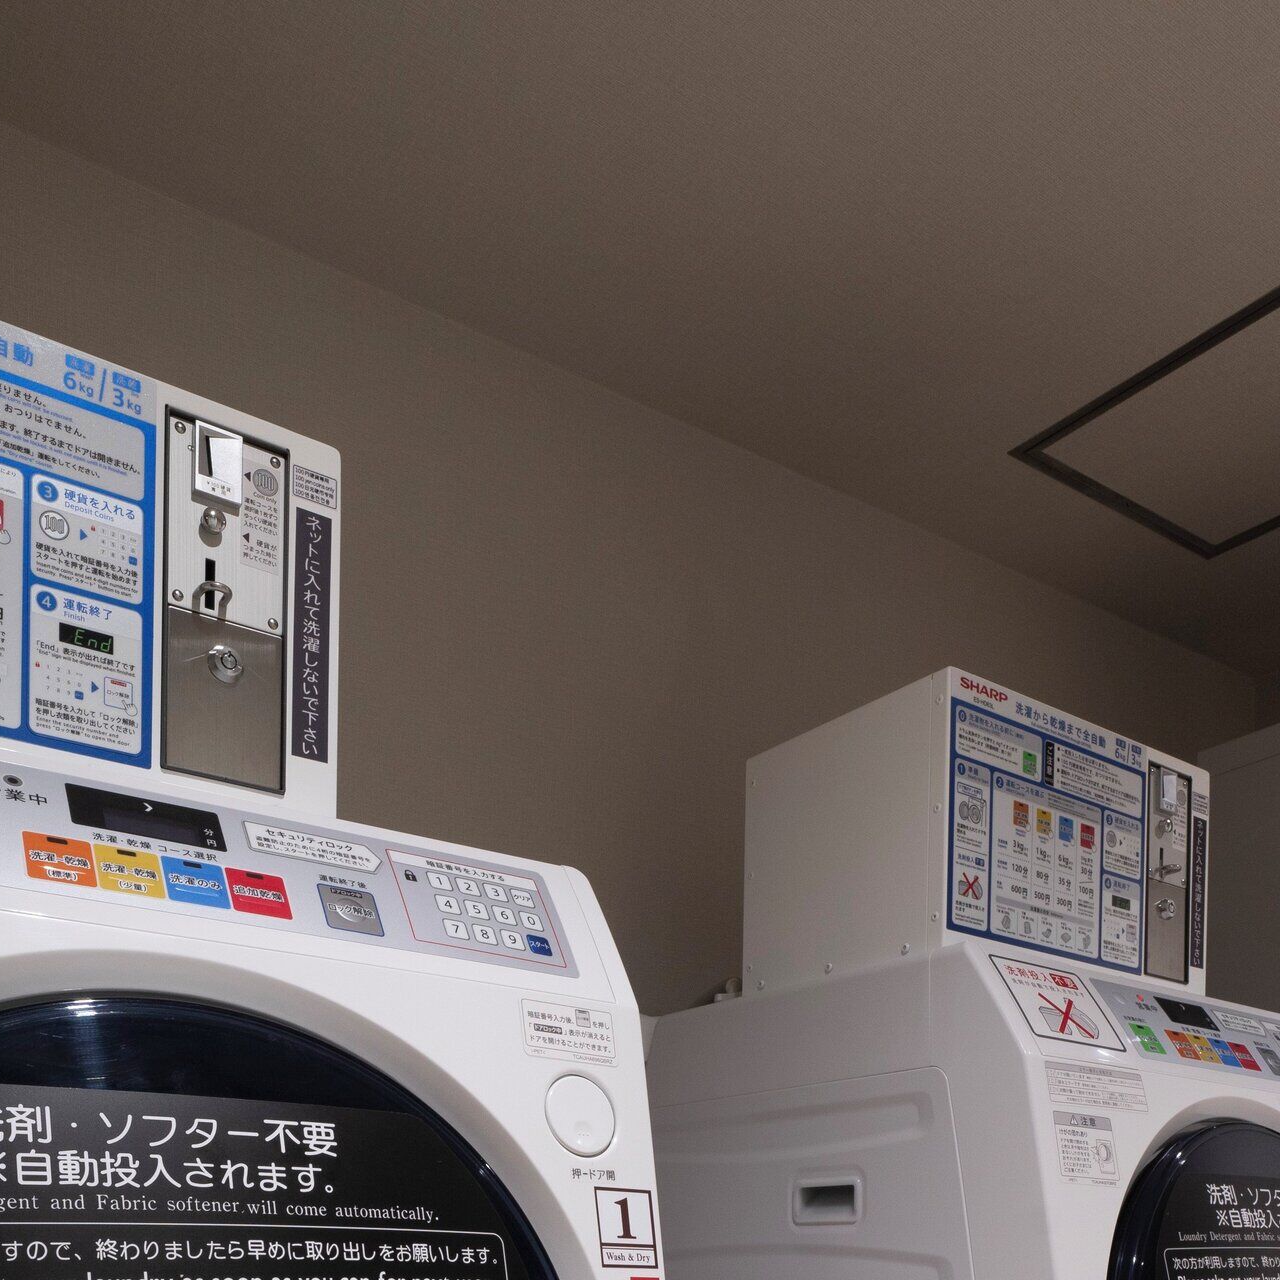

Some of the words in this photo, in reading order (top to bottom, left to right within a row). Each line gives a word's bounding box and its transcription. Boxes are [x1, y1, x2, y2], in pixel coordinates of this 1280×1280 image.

[64, 488, 135, 520] 硬貨を入れる
[64, 501, 91, 517] Deposit
[93, 509, 114, 522] Coins
[63, 598, 113, 621] 運転終了
[64, 612, 85, 623] Finish
[74, 629, 111, 652] End
[302, 516, 322, 756] ネットに入れて洗濯しないで下さい
[960, 676, 1008, 702] SHARP
[203, 828, 214, 838] 分
[207, 838, 217, 848] 円
[265, 828, 353, 852] セキュリティロック
[158, 844, 217, 862] コース選択
[426, 859, 505, 882] 暗証番号を入力する
[169, 873, 221, 891] 洗濯のみ
[318, 875, 367, 889] 運転終了後
[464, 881, 473, 893] 2
[491, 887, 499, 898] 3
[513, 893, 531, 903] クリア
[234, 885, 283, 903] 追加乾燥
[327, 902, 374, 919] ロック解除
[444, 899, 454, 911] 4
[473, 903, 481, 915] 5
[501, 909, 509, 920] 6
[452, 923, 459, 935] 7
[481, 929, 489, 940] 8
[508, 934, 516, 945] 9
[529, 940, 550, 952] スタート
[50, 1194, 86, 1210] and
[96, 1194, 157, 1212] Fabric
[247, 1201, 277, 1215] will
[286, 1204, 327, 1216] come
[335, 1206, 439, 1223] automatically.
[614, 1197, 636, 1239] 1
[1210, 1232, 1241, 1242] Detergent
[1257, 1232, 1275, 1241] Fabric
[606, 1251, 625, 1261] Wash
[628, 1253, 634, 1261] &
[637, 1253, 650, 1264] Dry
